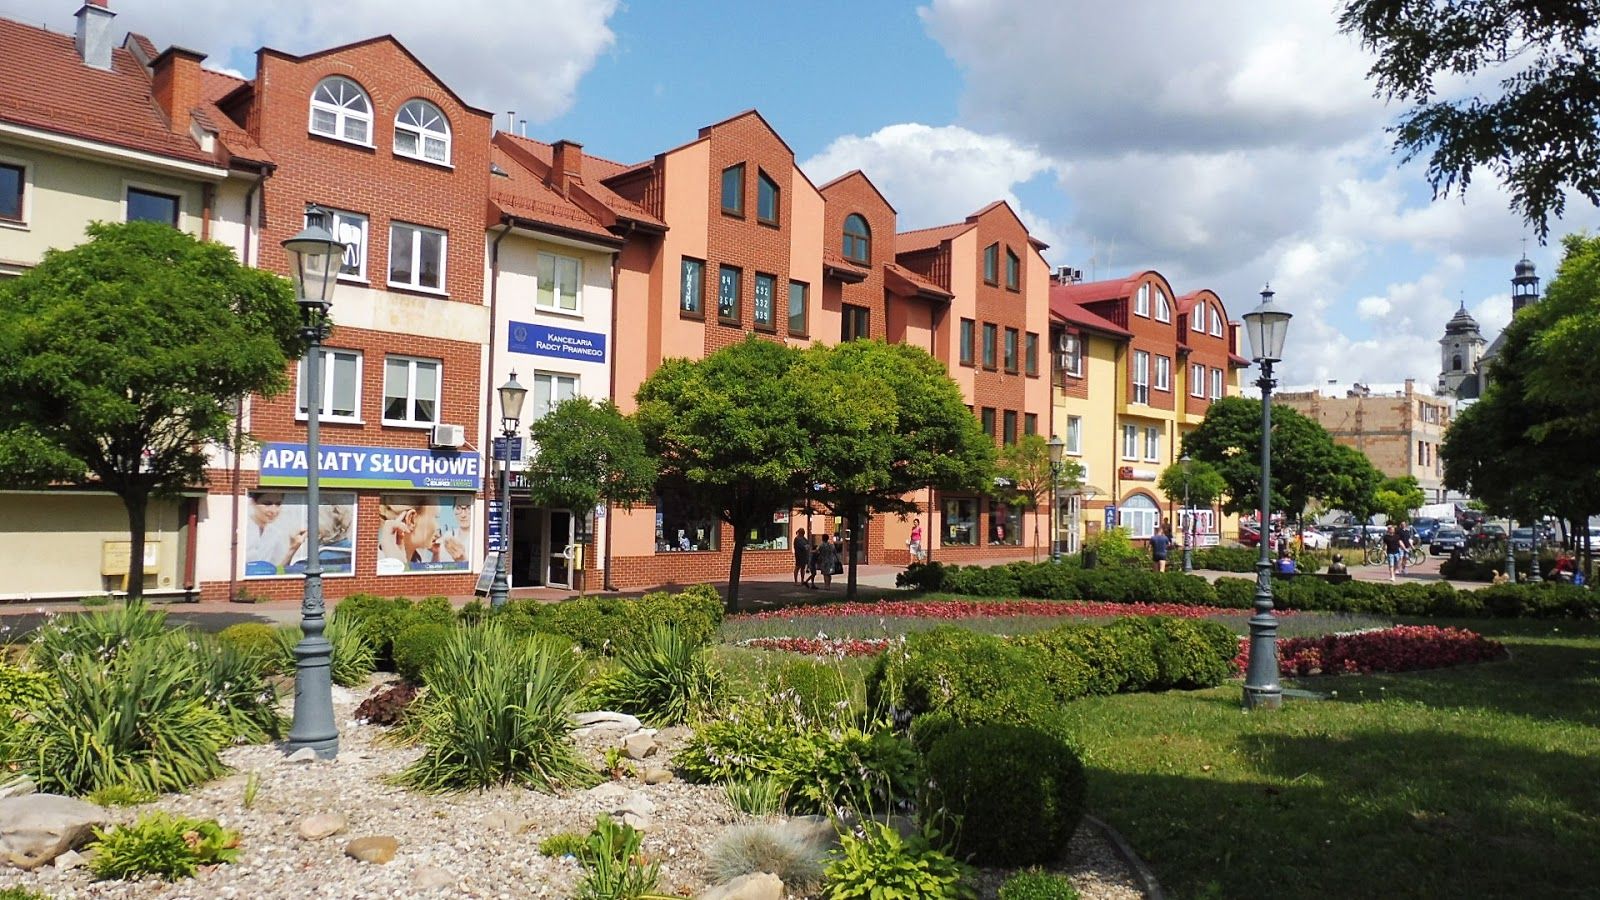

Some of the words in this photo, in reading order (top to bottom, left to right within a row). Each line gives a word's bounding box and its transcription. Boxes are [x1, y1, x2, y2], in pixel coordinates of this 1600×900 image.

[722, 275, 731, 286] 84
[719, 295, 734, 307] 350
[536, 341, 562, 351] RADCY
[562, 344, 604, 357] PRAWNEGO
[370, 453, 477, 475] SŁUCHOWE
